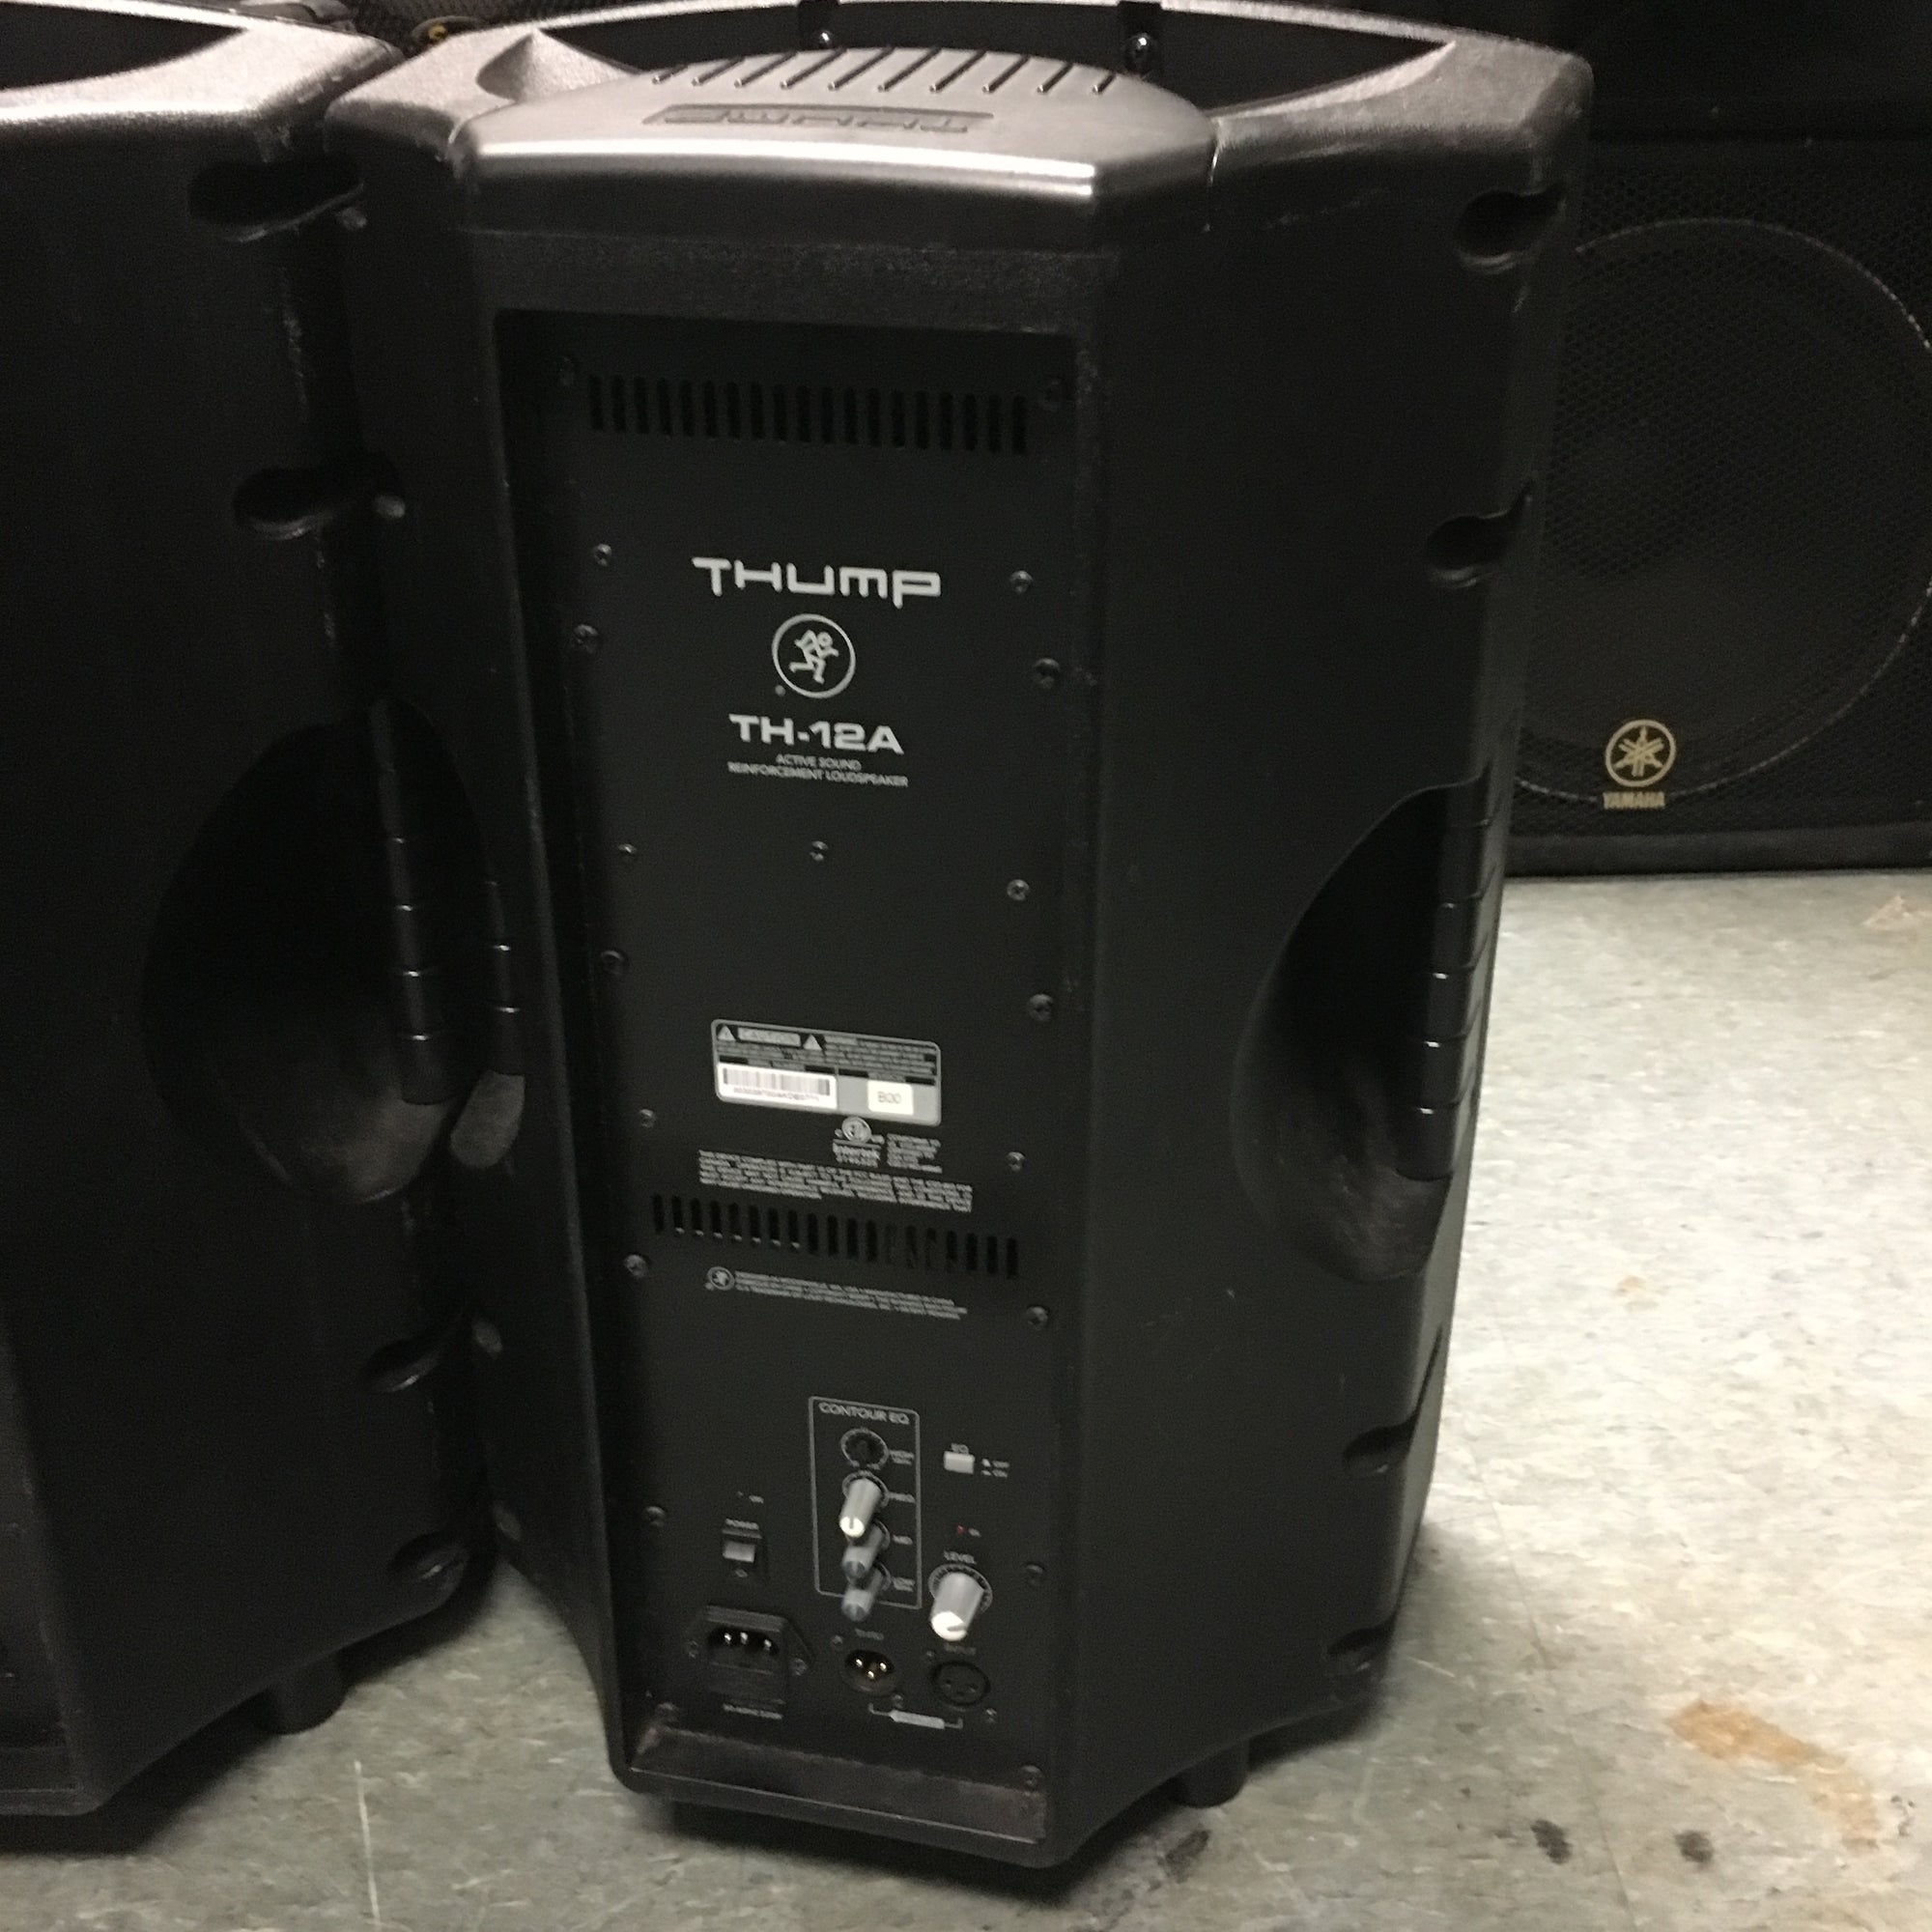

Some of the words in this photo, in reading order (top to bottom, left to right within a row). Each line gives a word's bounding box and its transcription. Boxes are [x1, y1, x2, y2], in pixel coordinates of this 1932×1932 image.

[691, 556, 942, 610] THUMP
[728, 713, 904, 754] TH-12A
[726, 760, 825, 781] REINFORCEMENT
[825, 769, 909, 788] LOUDSPEAKER
[775, 753, 817, 769] ACTIVE
[818, 755, 863, 772] SOUND
[818, 1402, 888, 1423] CONTOUR
[888, 1410, 911, 1426] EQ
